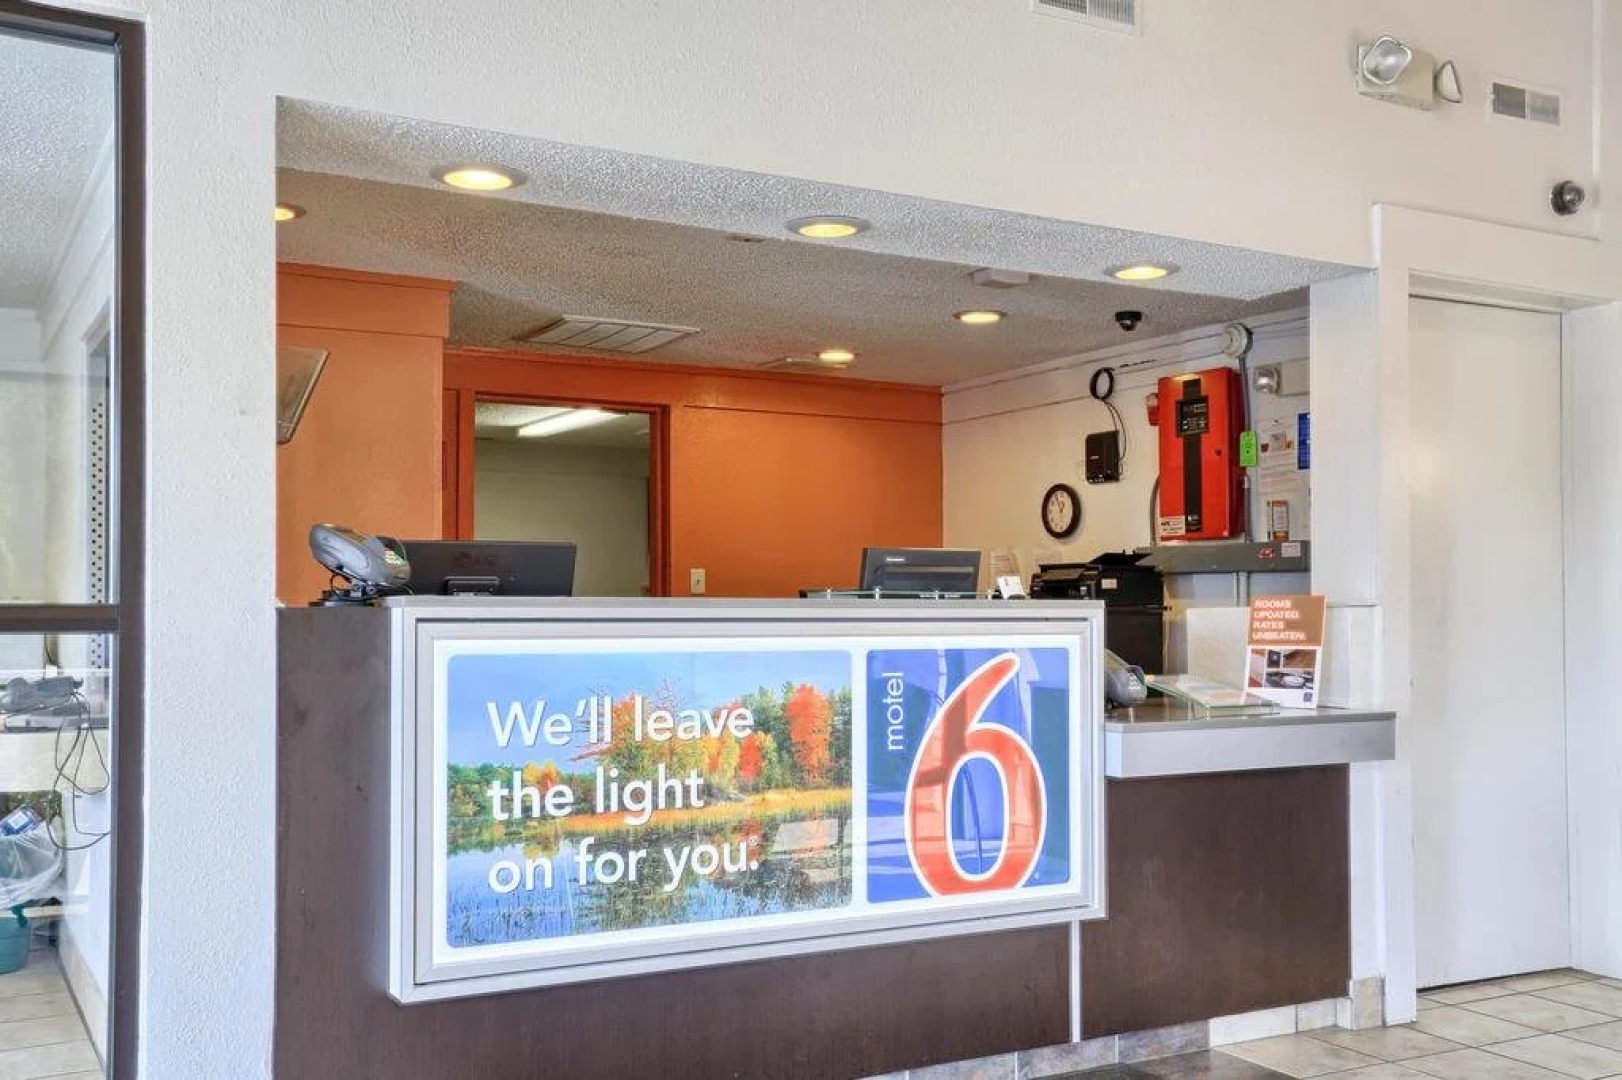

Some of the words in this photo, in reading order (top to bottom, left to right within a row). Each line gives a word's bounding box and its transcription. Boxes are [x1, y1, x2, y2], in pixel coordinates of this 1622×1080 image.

[487, 697, 613, 748] We'll
[633, 695, 754, 743] leave
[882, 672, 904, 751] motel
[488, 771, 573, 821] the
[596, 762, 705, 825] light
[904, 651, 1048, 899] 6
[488, 855, 553, 894] on
[574, 837, 646, 886] for
